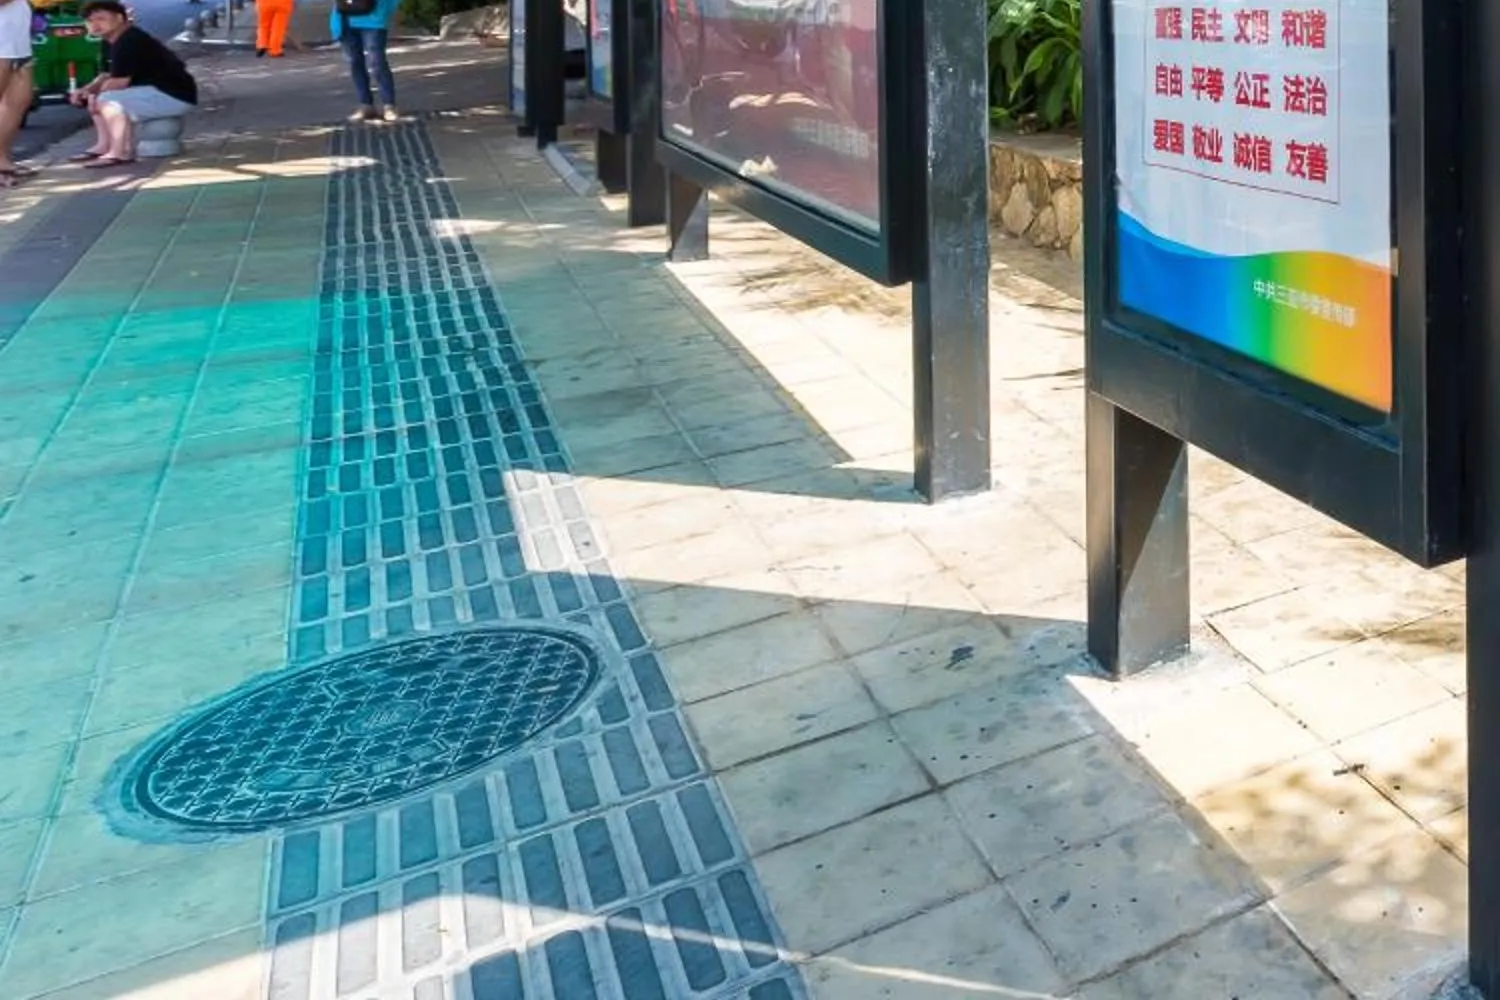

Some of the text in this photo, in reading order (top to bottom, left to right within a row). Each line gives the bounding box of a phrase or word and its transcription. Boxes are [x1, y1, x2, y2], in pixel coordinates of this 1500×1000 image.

[1154, 7, 1328, 49] 富强 民主 文明 和谐
[1154, 62, 1328, 117] 自由 平等 公正 法治
[1153, 119, 1329, 184] 爱国 敬业 诚信 友善
